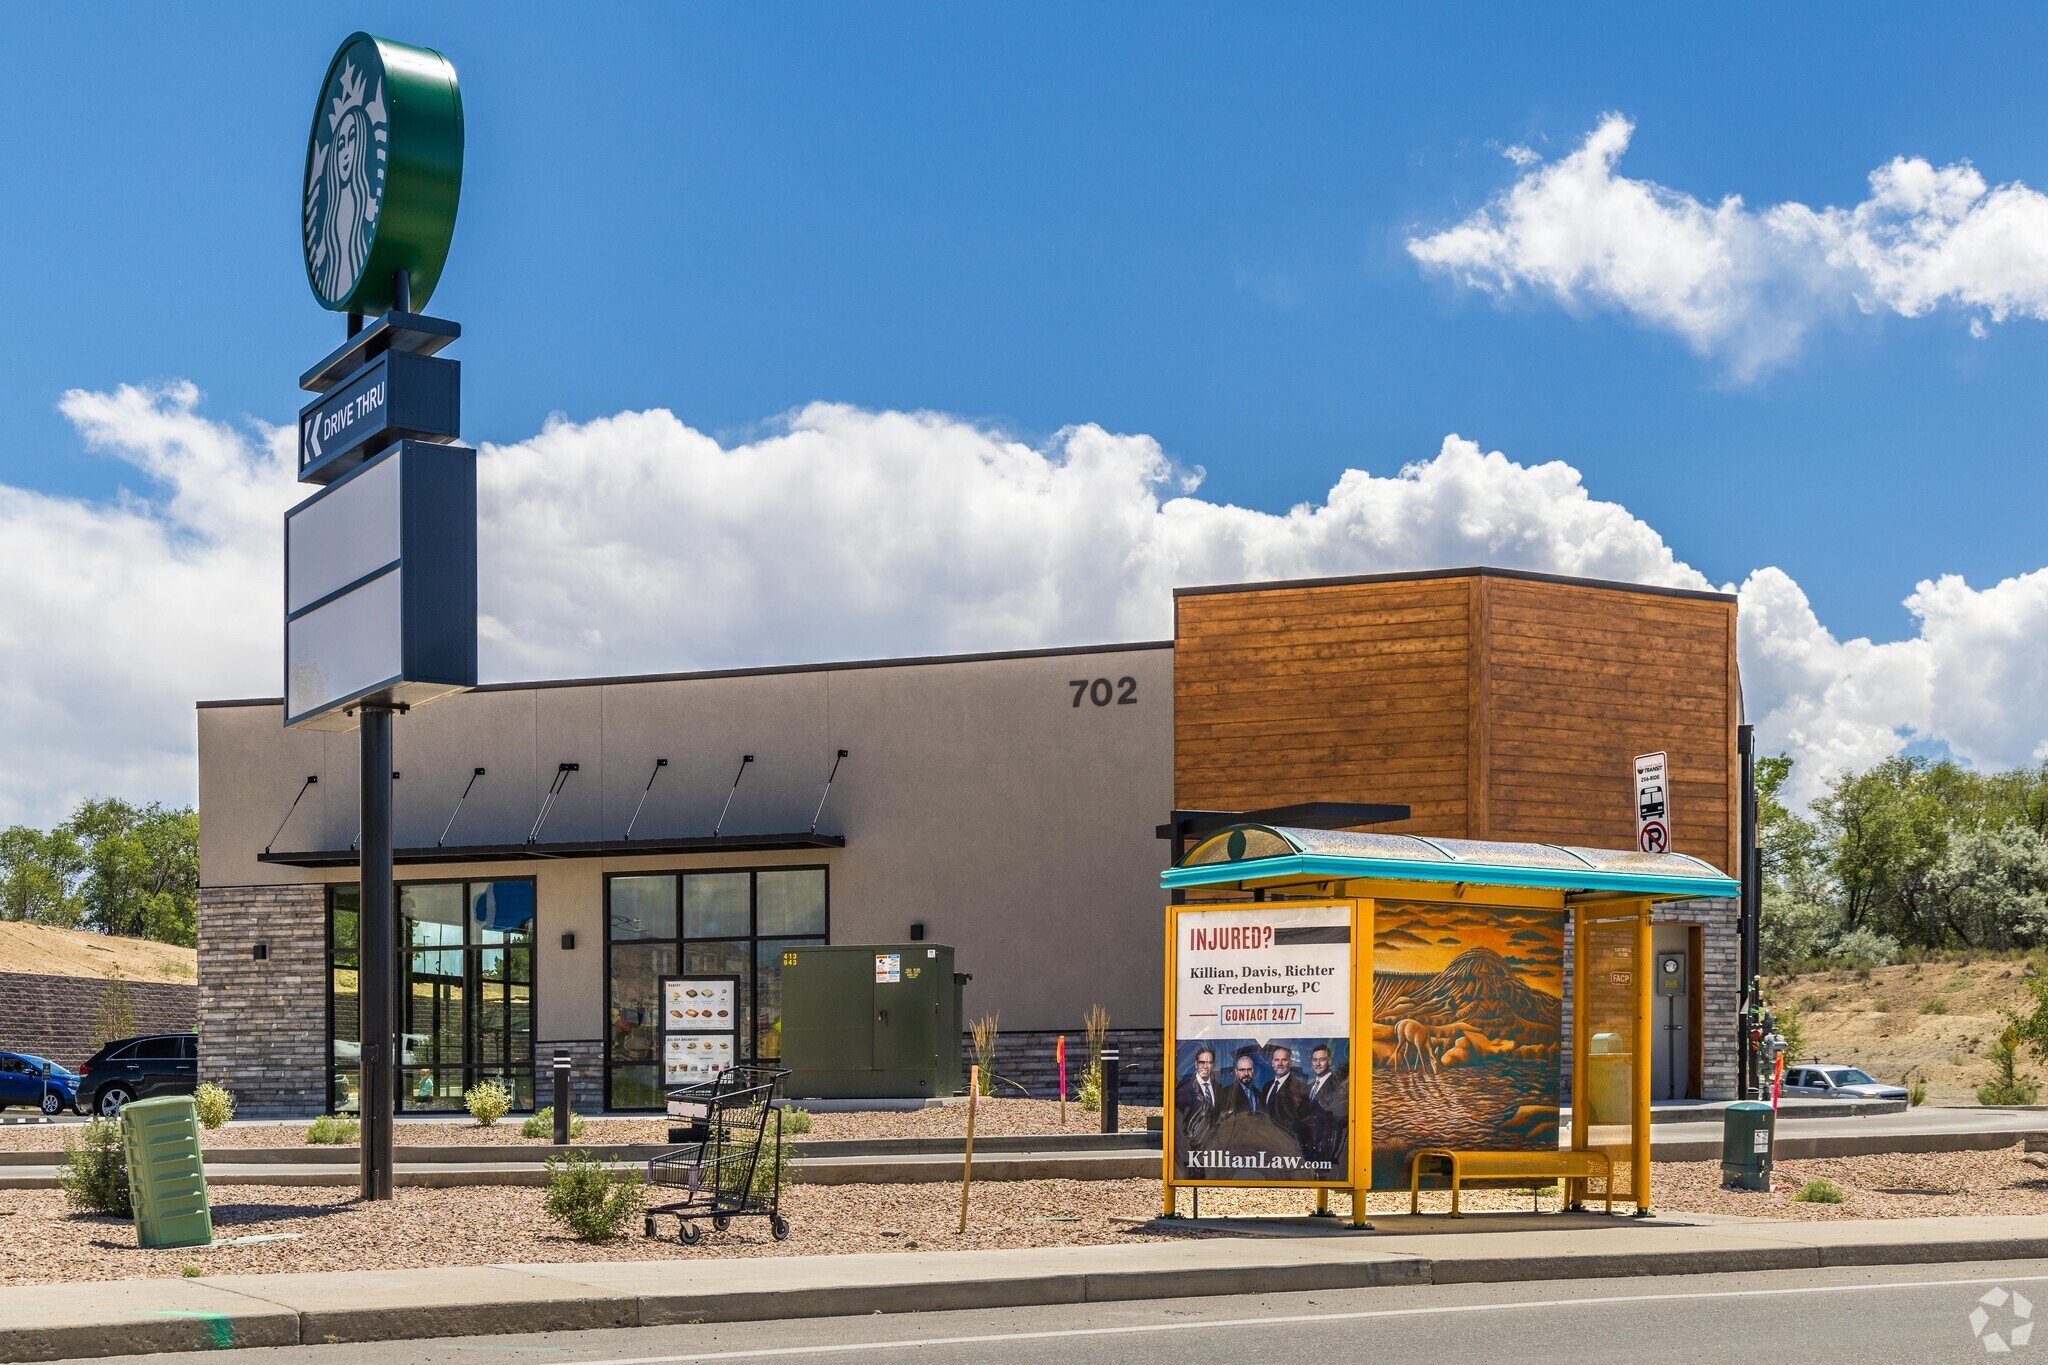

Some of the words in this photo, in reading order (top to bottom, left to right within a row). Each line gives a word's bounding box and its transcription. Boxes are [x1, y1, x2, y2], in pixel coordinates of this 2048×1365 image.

[324, 402, 354, 441] DRIVE
[356, 381, 385, 419] THRU
[1069, 676, 1137, 708] 702
[1644, 765, 1663, 773] TRANSIT
[1190, 926, 1272, 951] INJURED?
[1190, 967, 1239, 980] Killian,
[1242, 966, 1282, 979] Davis,
[1285, 964, 1335, 977] Richter
[1612, 974, 1630, 982] FACP
[1203, 983, 1214, 995] &
[1218, 982, 1299, 997] Fredenburg,
[1301, 981, 1321, 993] PC
[1225, 1008, 1268, 1022] CONTACT
[1272, 1008, 1297, 1021] 24/7
[1187, 1150, 1332, 1170] KillianLaw.com
